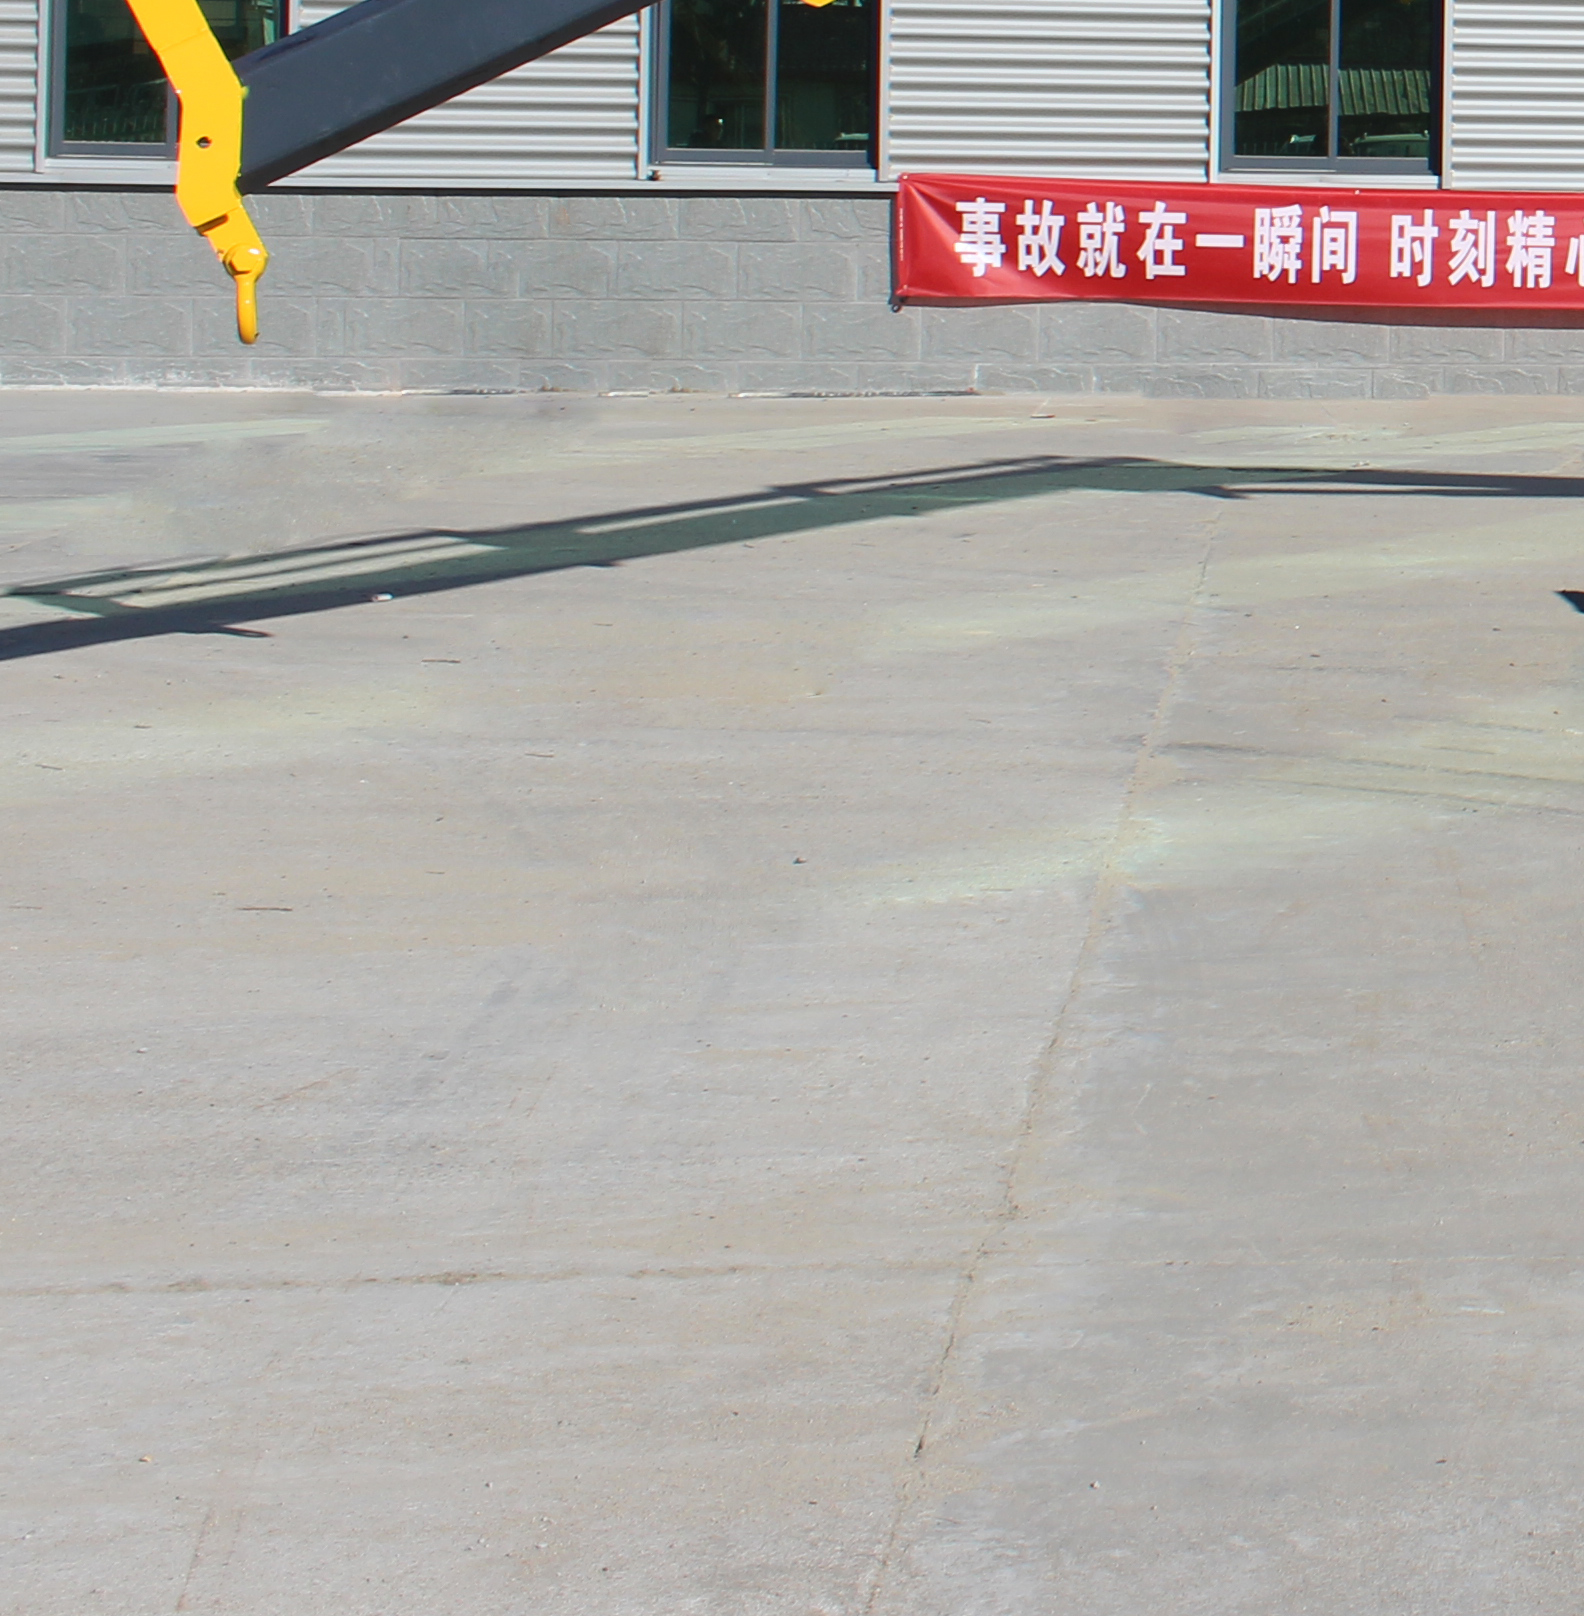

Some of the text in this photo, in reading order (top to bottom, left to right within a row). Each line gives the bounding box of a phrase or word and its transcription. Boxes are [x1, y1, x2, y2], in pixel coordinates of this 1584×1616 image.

[953, 197, 1359, 285] 事故就在一瞬间
